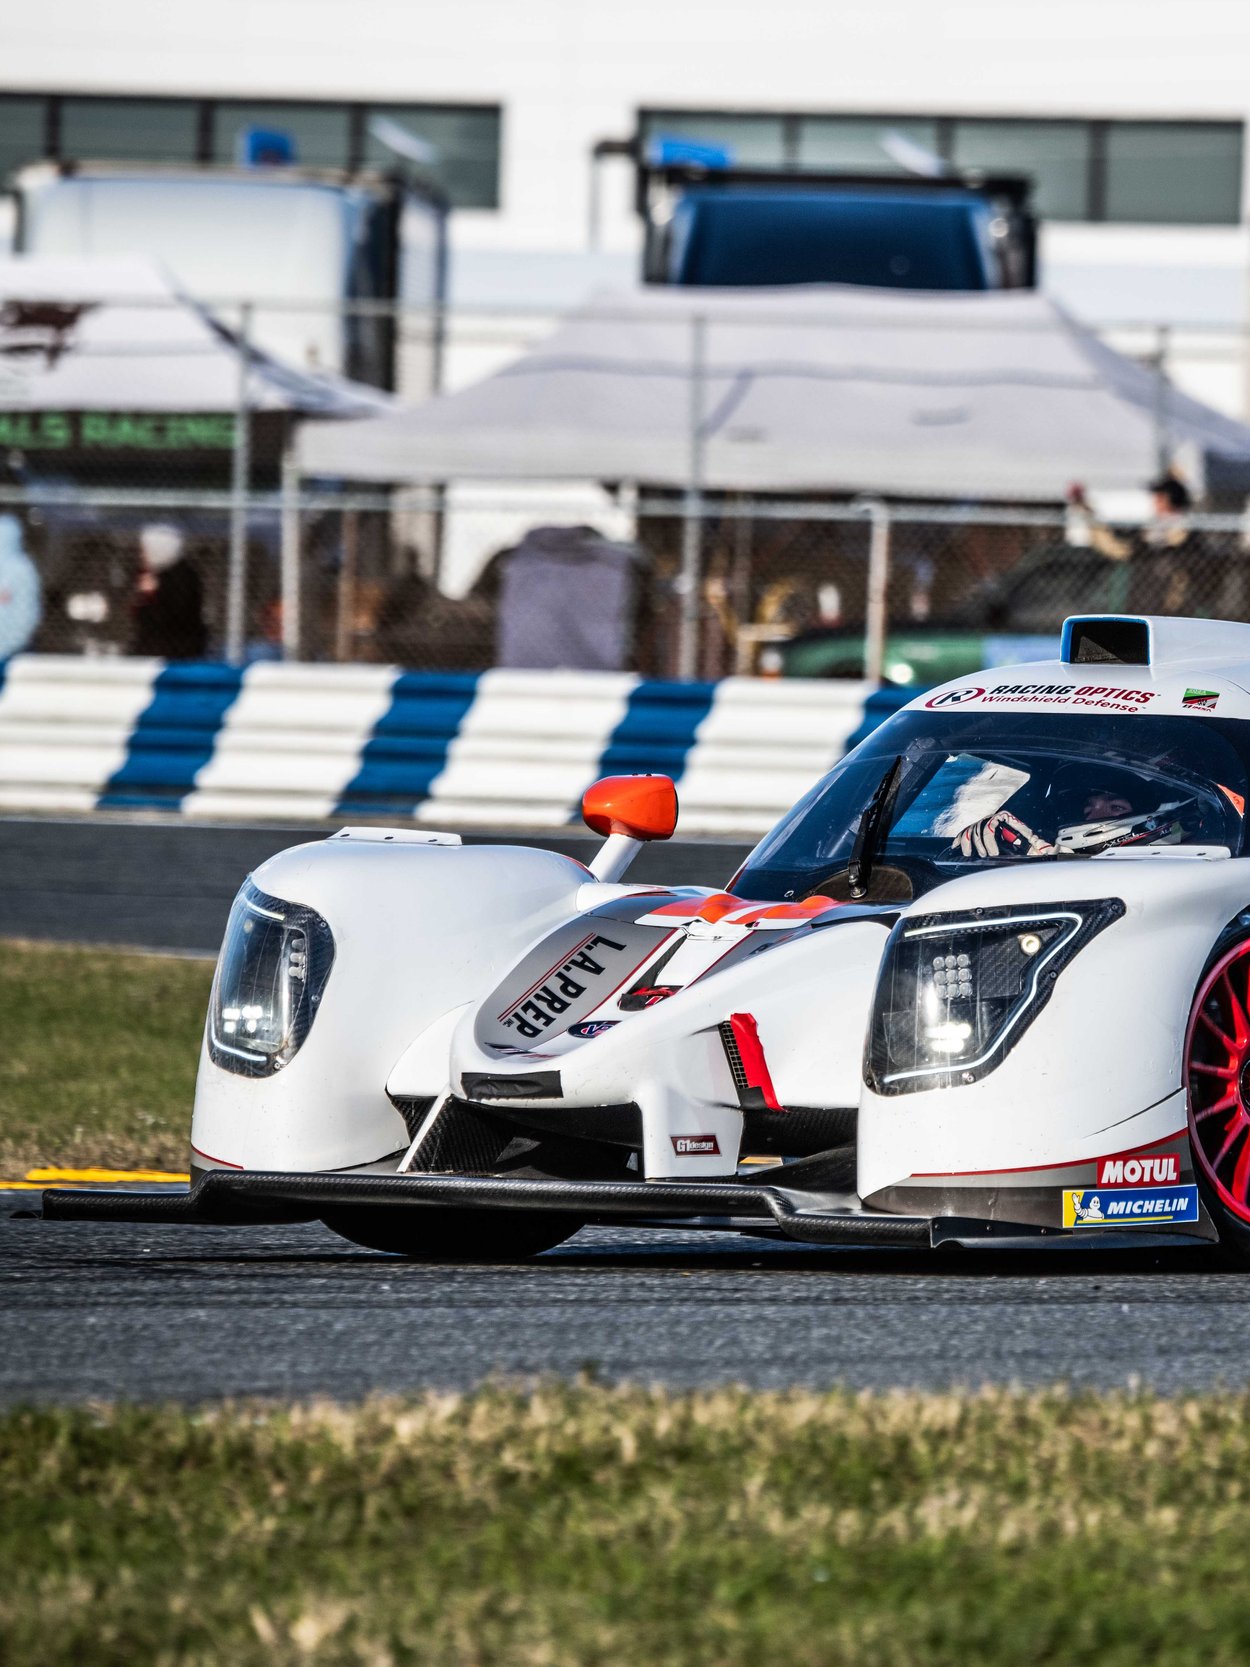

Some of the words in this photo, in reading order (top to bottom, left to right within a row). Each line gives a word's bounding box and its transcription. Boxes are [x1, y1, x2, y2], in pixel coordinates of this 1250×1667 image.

[988, 684, 1077, 695] RACING
[1073, 686, 1155, 704] OPTICS
[981, 695, 1070, 704] Windshield
[1072, 696, 1139, 713] Defense
[1101, 1158, 1177, 1184] MOTUL
[1107, 1197, 1189, 1215] MICHELIN
